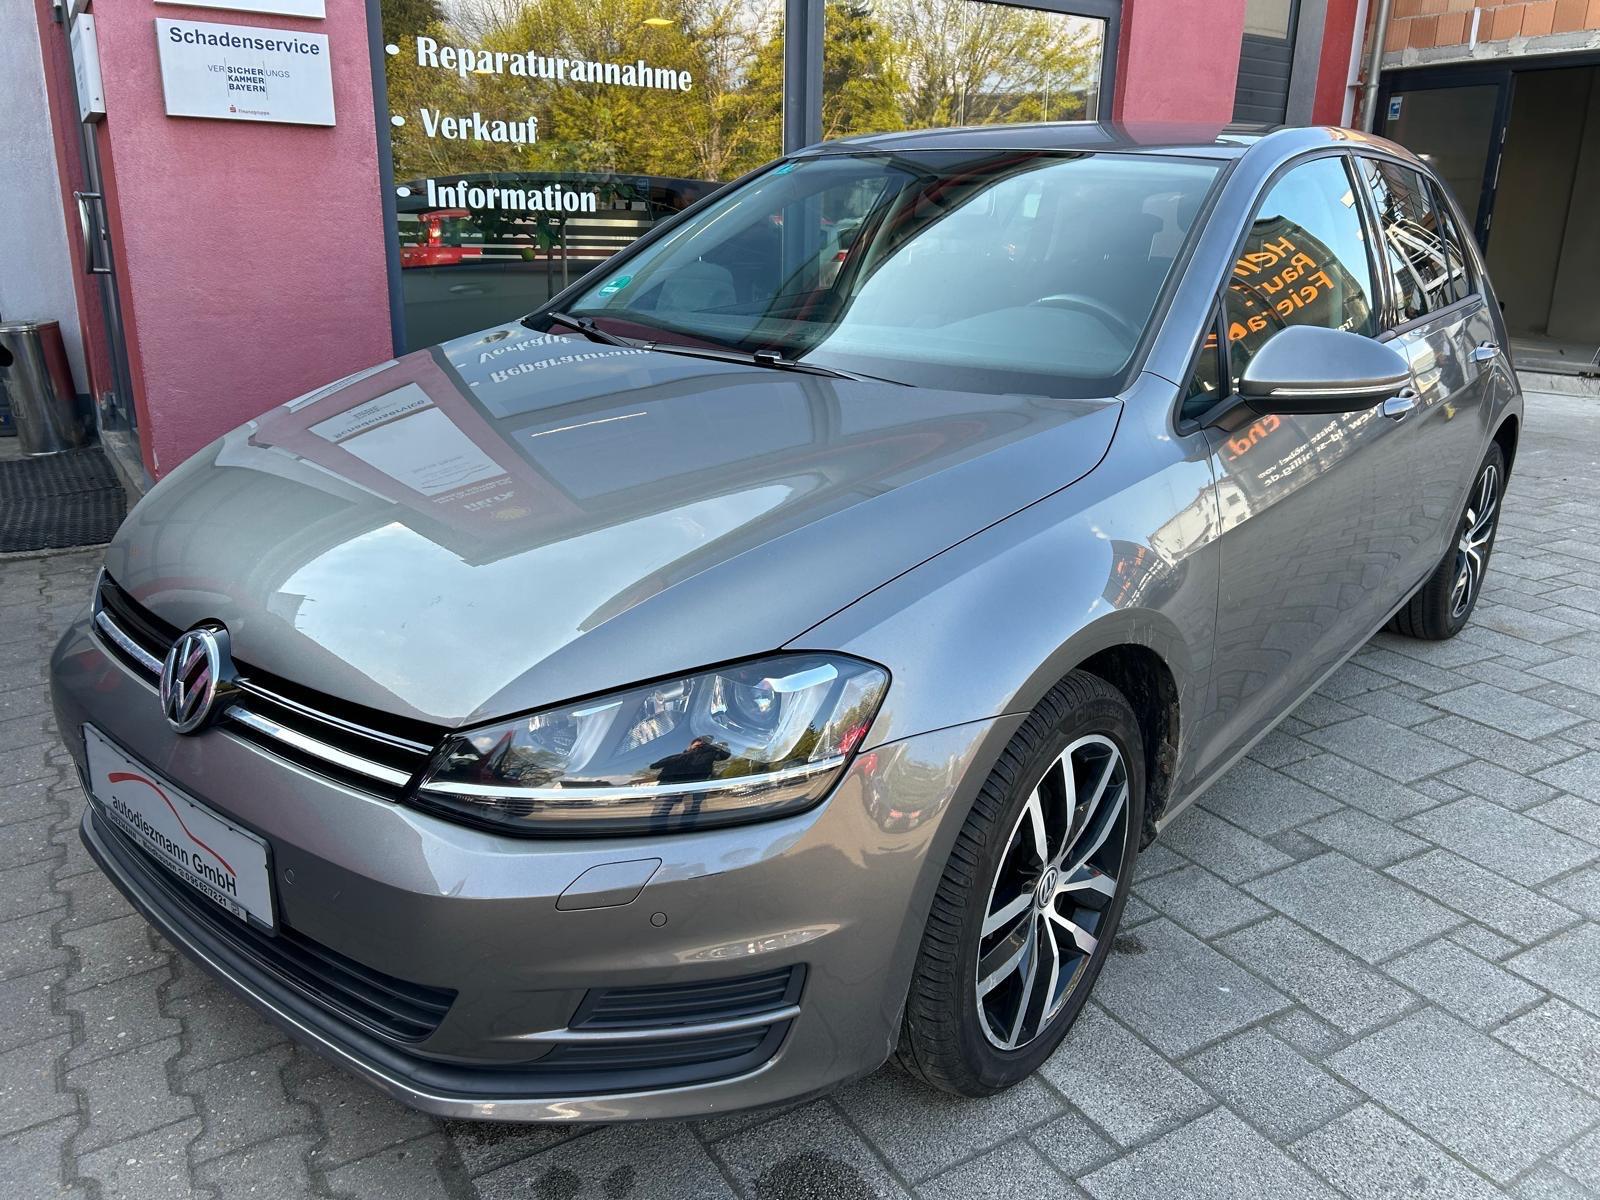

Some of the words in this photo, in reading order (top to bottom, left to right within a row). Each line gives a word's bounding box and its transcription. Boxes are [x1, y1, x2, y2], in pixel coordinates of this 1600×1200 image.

[169, 26, 320, 56] Schadenservice
[227, 74, 265, 85] KAMMER
[416, 36, 693, 92] Reparaturannahme
[228, 83, 266, 93] BAYERN
[419, 108, 538, 144] Verkauf
[426, 179, 597, 213] Information
[112, 795, 189, 866] autodiezmann
[192, 853, 237, 897] GmbH
